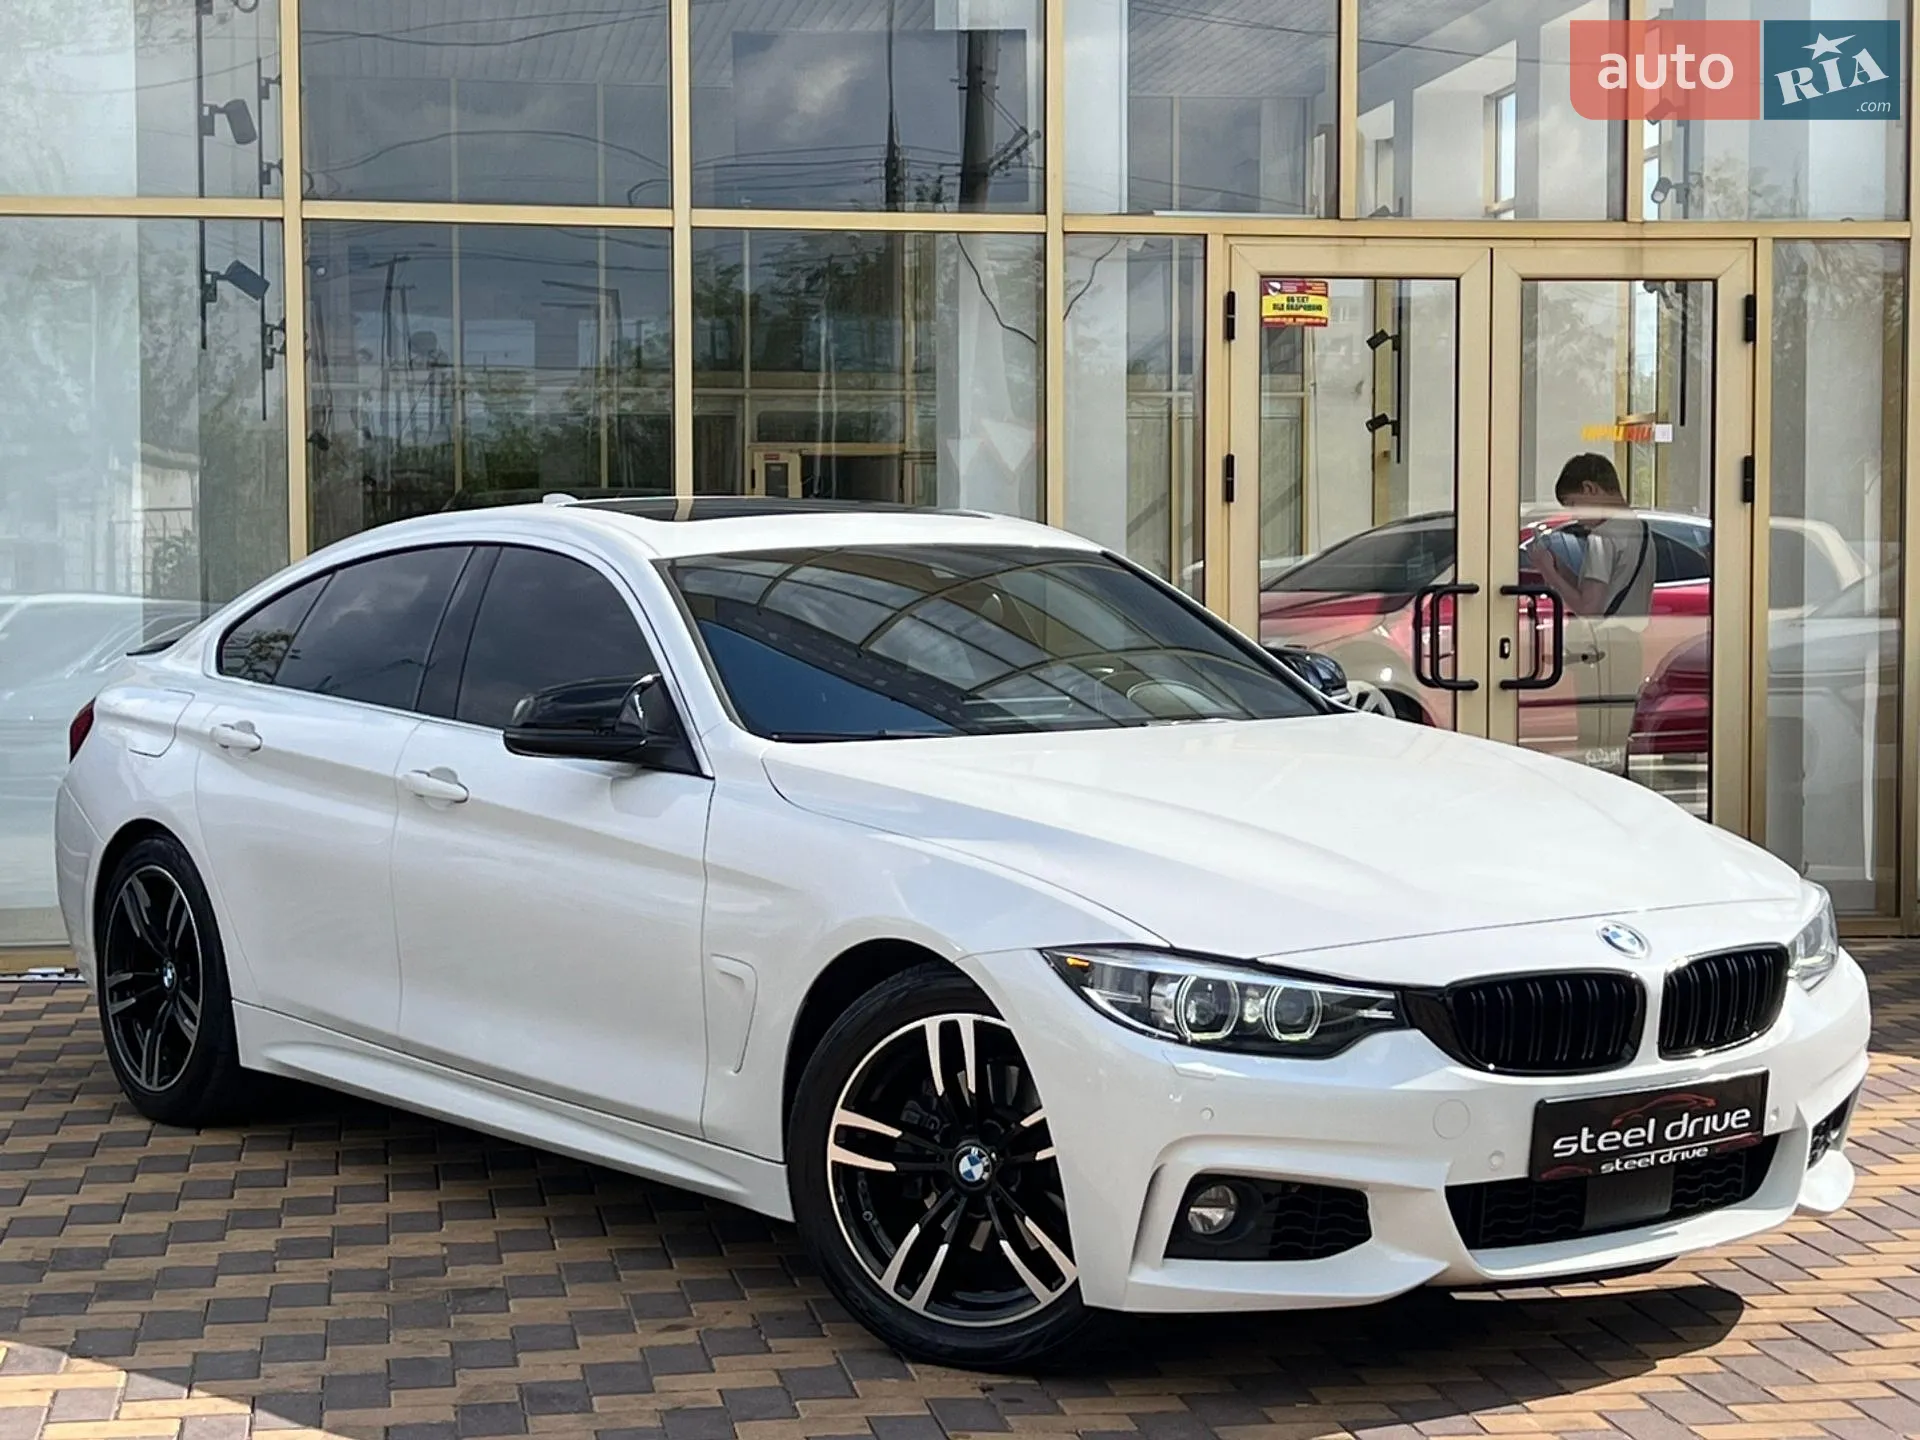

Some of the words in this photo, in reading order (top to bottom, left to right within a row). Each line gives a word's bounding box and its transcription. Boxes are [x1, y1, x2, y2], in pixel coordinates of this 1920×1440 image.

[1552, 1117, 1656, 1158] steel
[1664, 1107, 1752, 1141] drive
[1600, 1152, 1655, 1174] steel
[1659, 1146, 1709, 1165] drive
